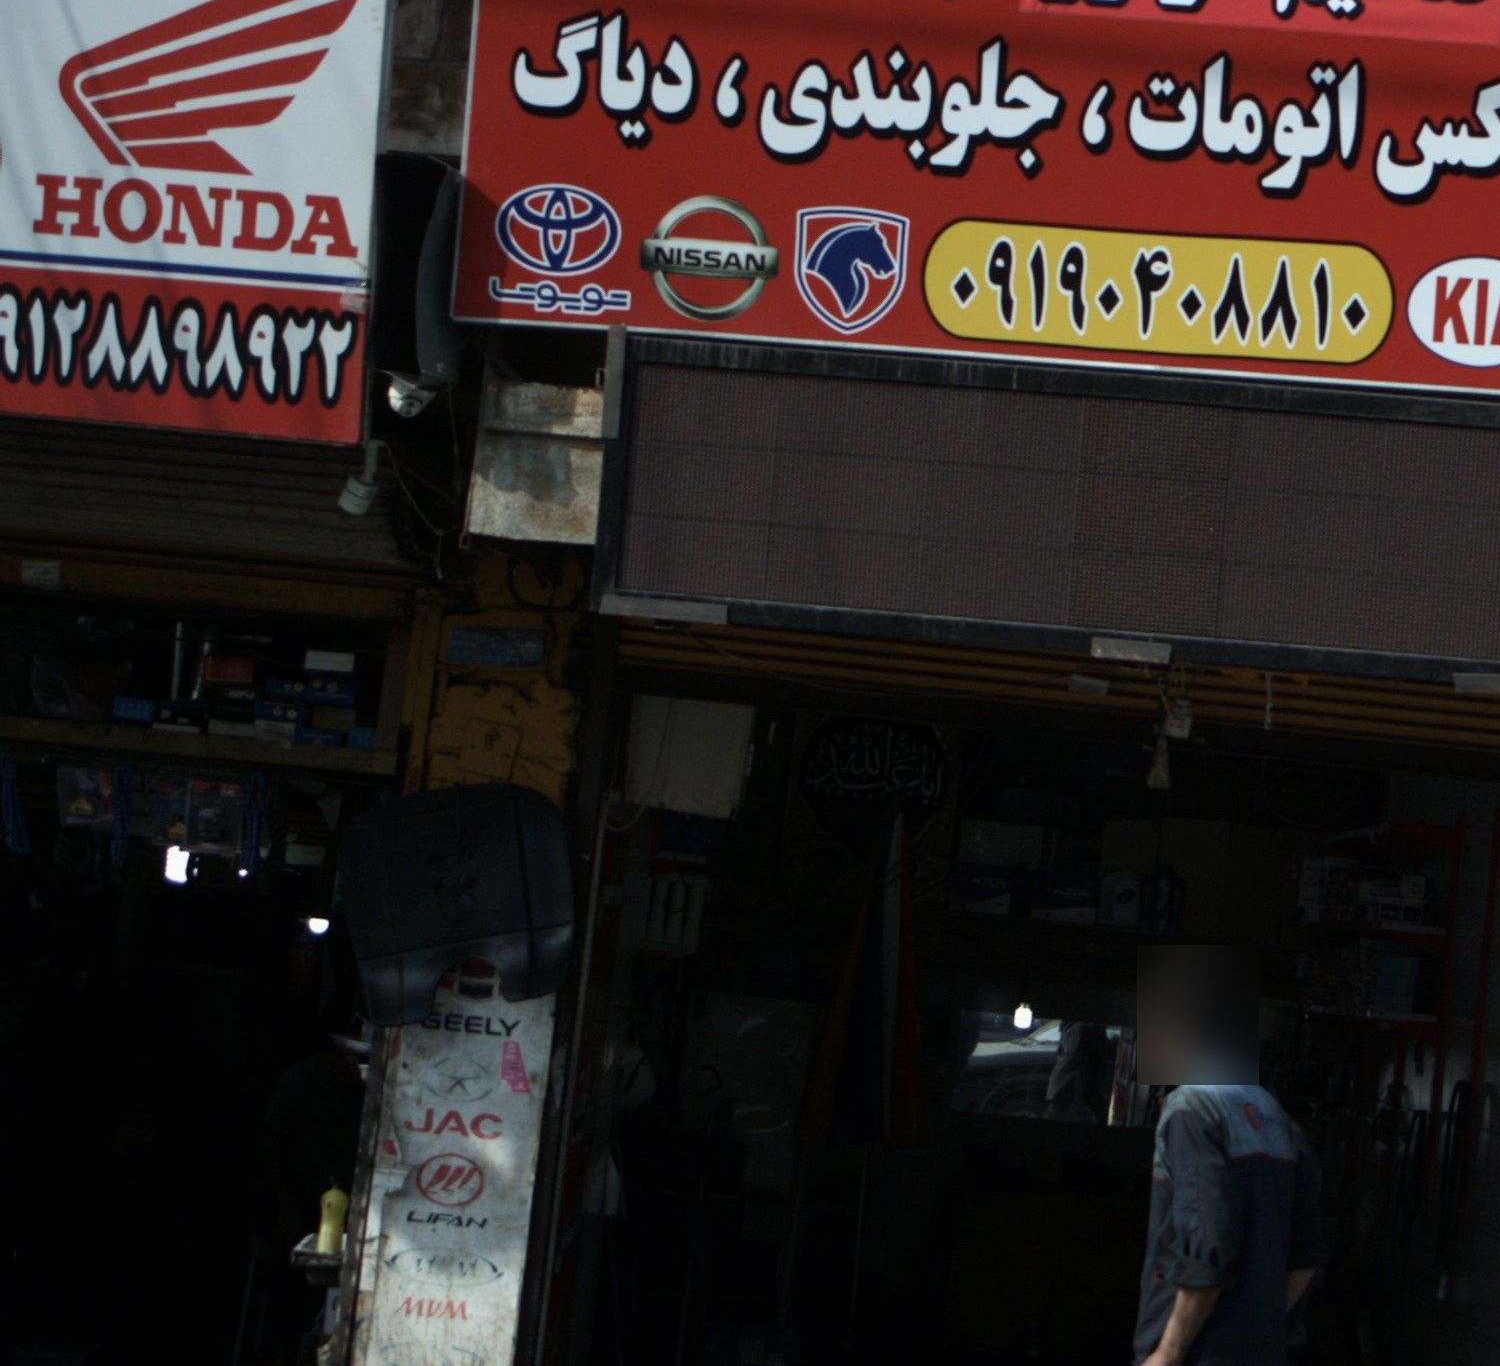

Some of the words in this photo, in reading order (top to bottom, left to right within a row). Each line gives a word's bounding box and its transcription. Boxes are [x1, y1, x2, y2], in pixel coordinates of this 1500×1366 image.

[511, 10, 700, 148] دیاگ
[32, 172, 359, 260] HONDA
[652, 245, 767, 272] NISSAN
[949, 236, 1369, 350] ۰۹۱۹۰۴۰۸۸۱۰
[420, 1011, 522, 1038] GEELY
[403, 1107, 504, 1141] JAC
[406, 1210, 489, 1230] LIFAN
[395, 1295, 469, 1322] MVM
